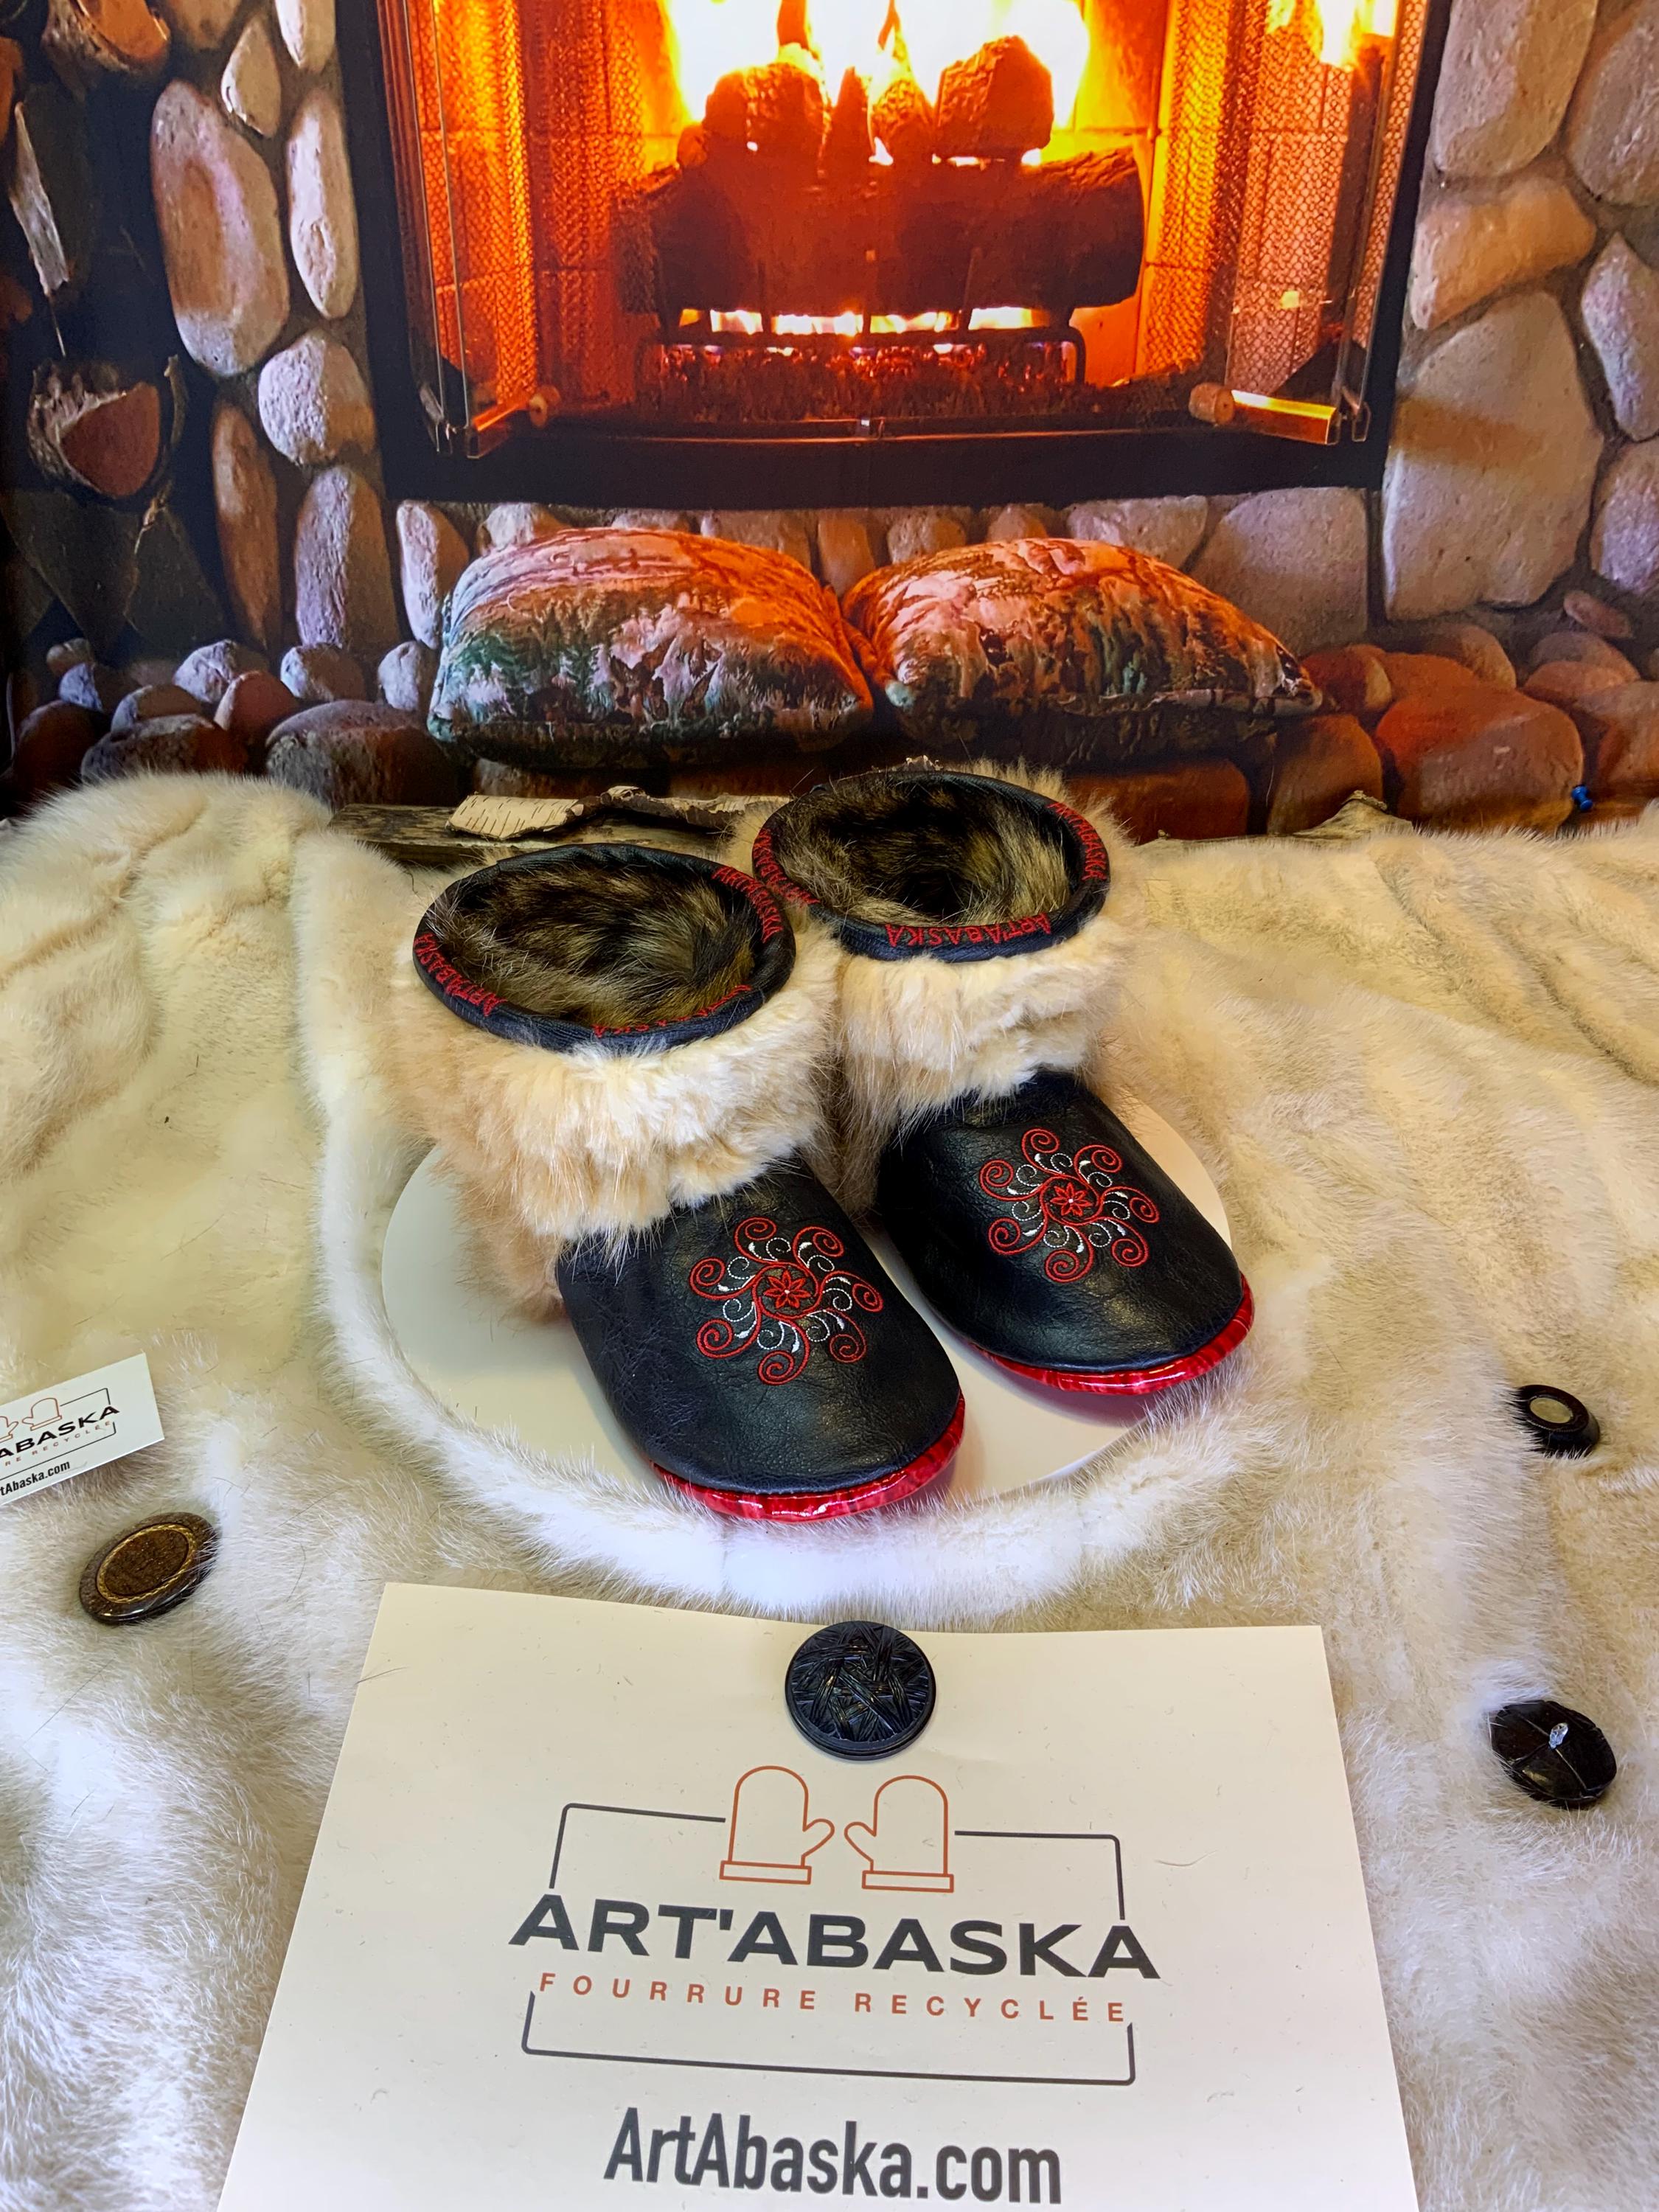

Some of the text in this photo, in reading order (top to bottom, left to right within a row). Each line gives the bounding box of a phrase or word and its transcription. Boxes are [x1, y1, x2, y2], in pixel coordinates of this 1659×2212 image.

[508, 1893, 1161, 1980] ART'ABASKA
[540, 1972, 1123, 2023] FOURRURE RECYCLÉE
[603, 2107, 1062, 2205] ArtAbaska.com
